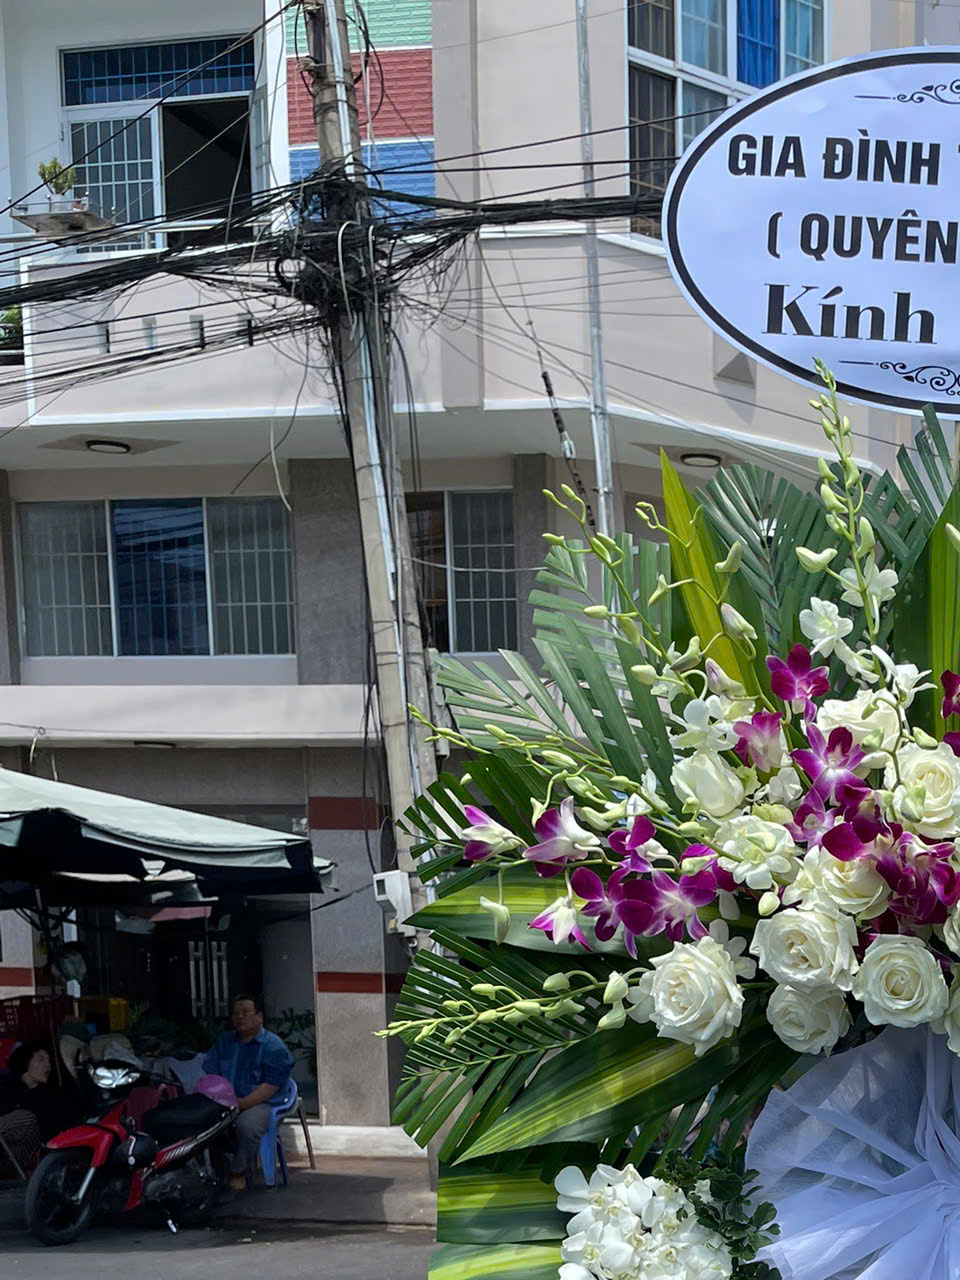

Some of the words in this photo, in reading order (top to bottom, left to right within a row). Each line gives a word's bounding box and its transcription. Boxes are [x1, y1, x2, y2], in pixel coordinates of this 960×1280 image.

[727, 133, 807, 178] GIA
[822, 128, 941, 186] ĐÌNH
[799, 209, 959, 265] QUYÊN
[761, 283, 937, 345] Kính
